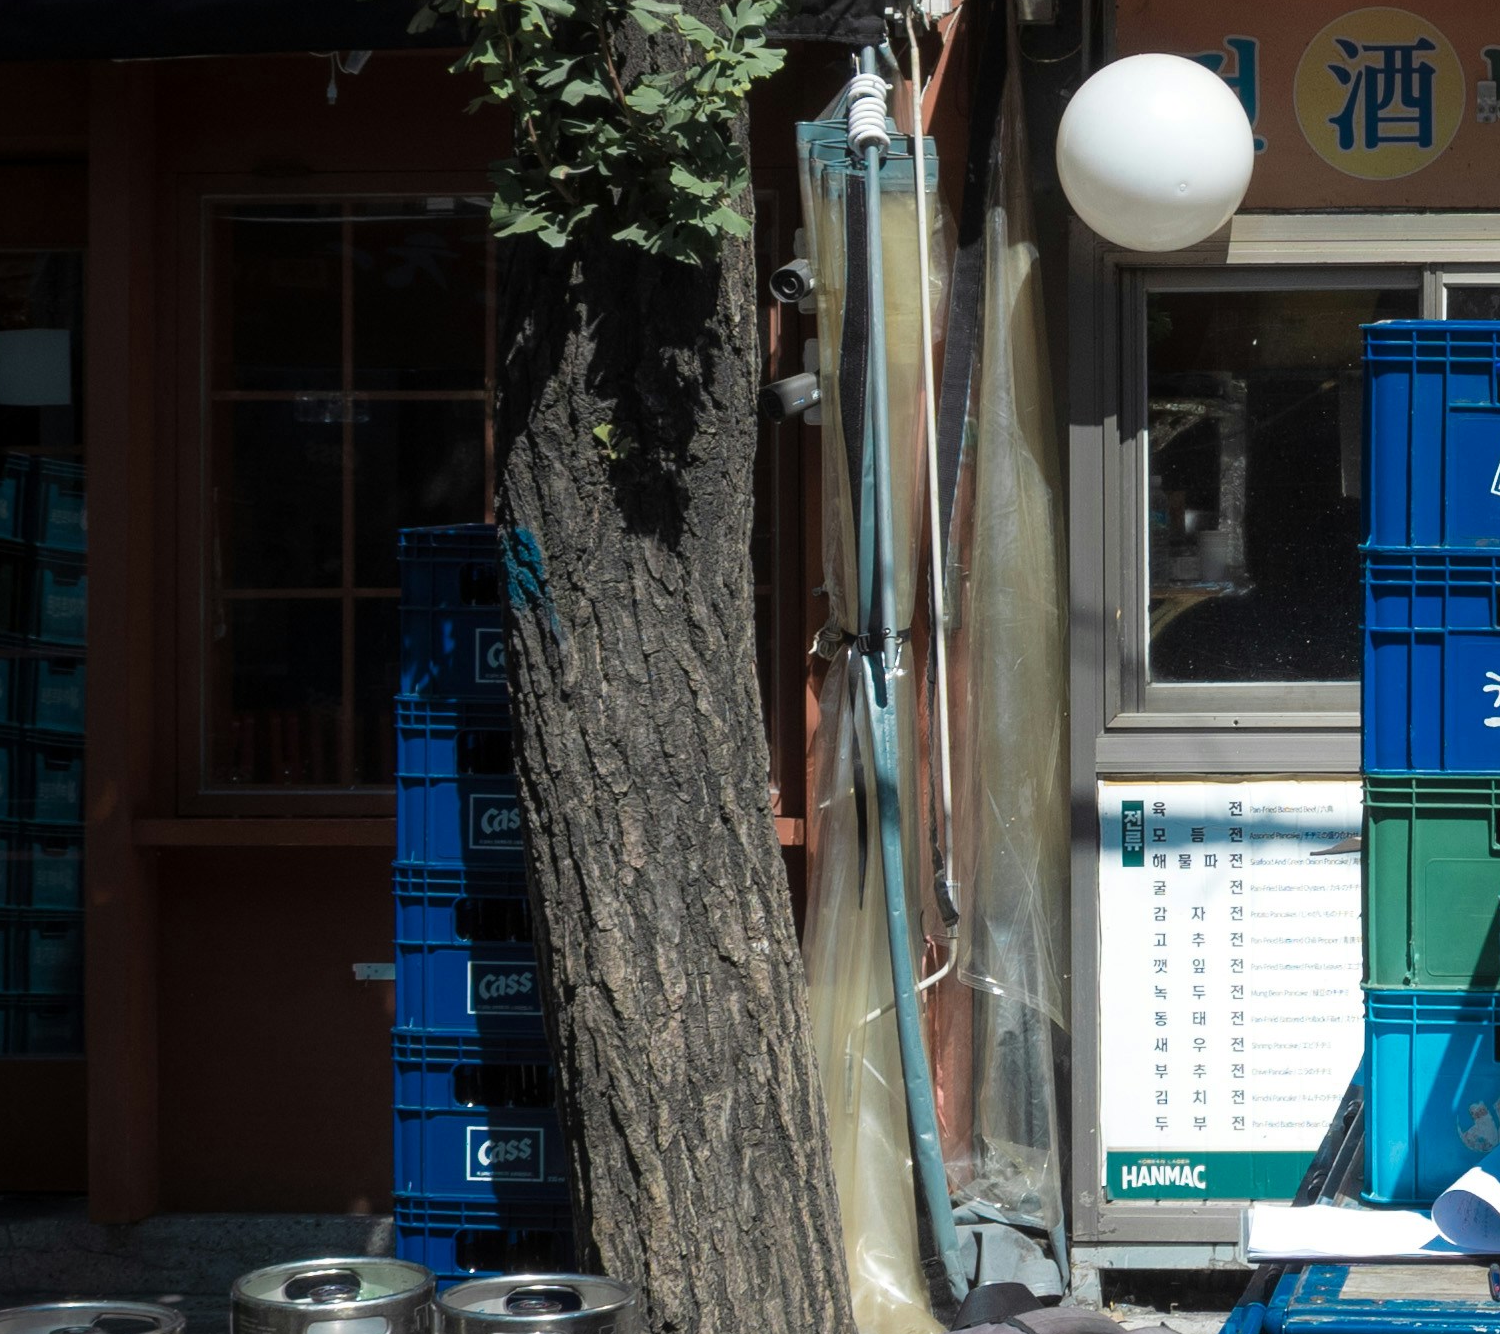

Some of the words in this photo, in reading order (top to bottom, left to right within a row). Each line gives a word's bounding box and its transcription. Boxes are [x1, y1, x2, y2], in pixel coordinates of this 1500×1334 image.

[1327, 36, 1437, 151] 酒
[477, 969, 534, 1001] Cass
[477, 1138, 533, 1169] Cass
[1122, 1165, 1206, 1190] HANMAC
